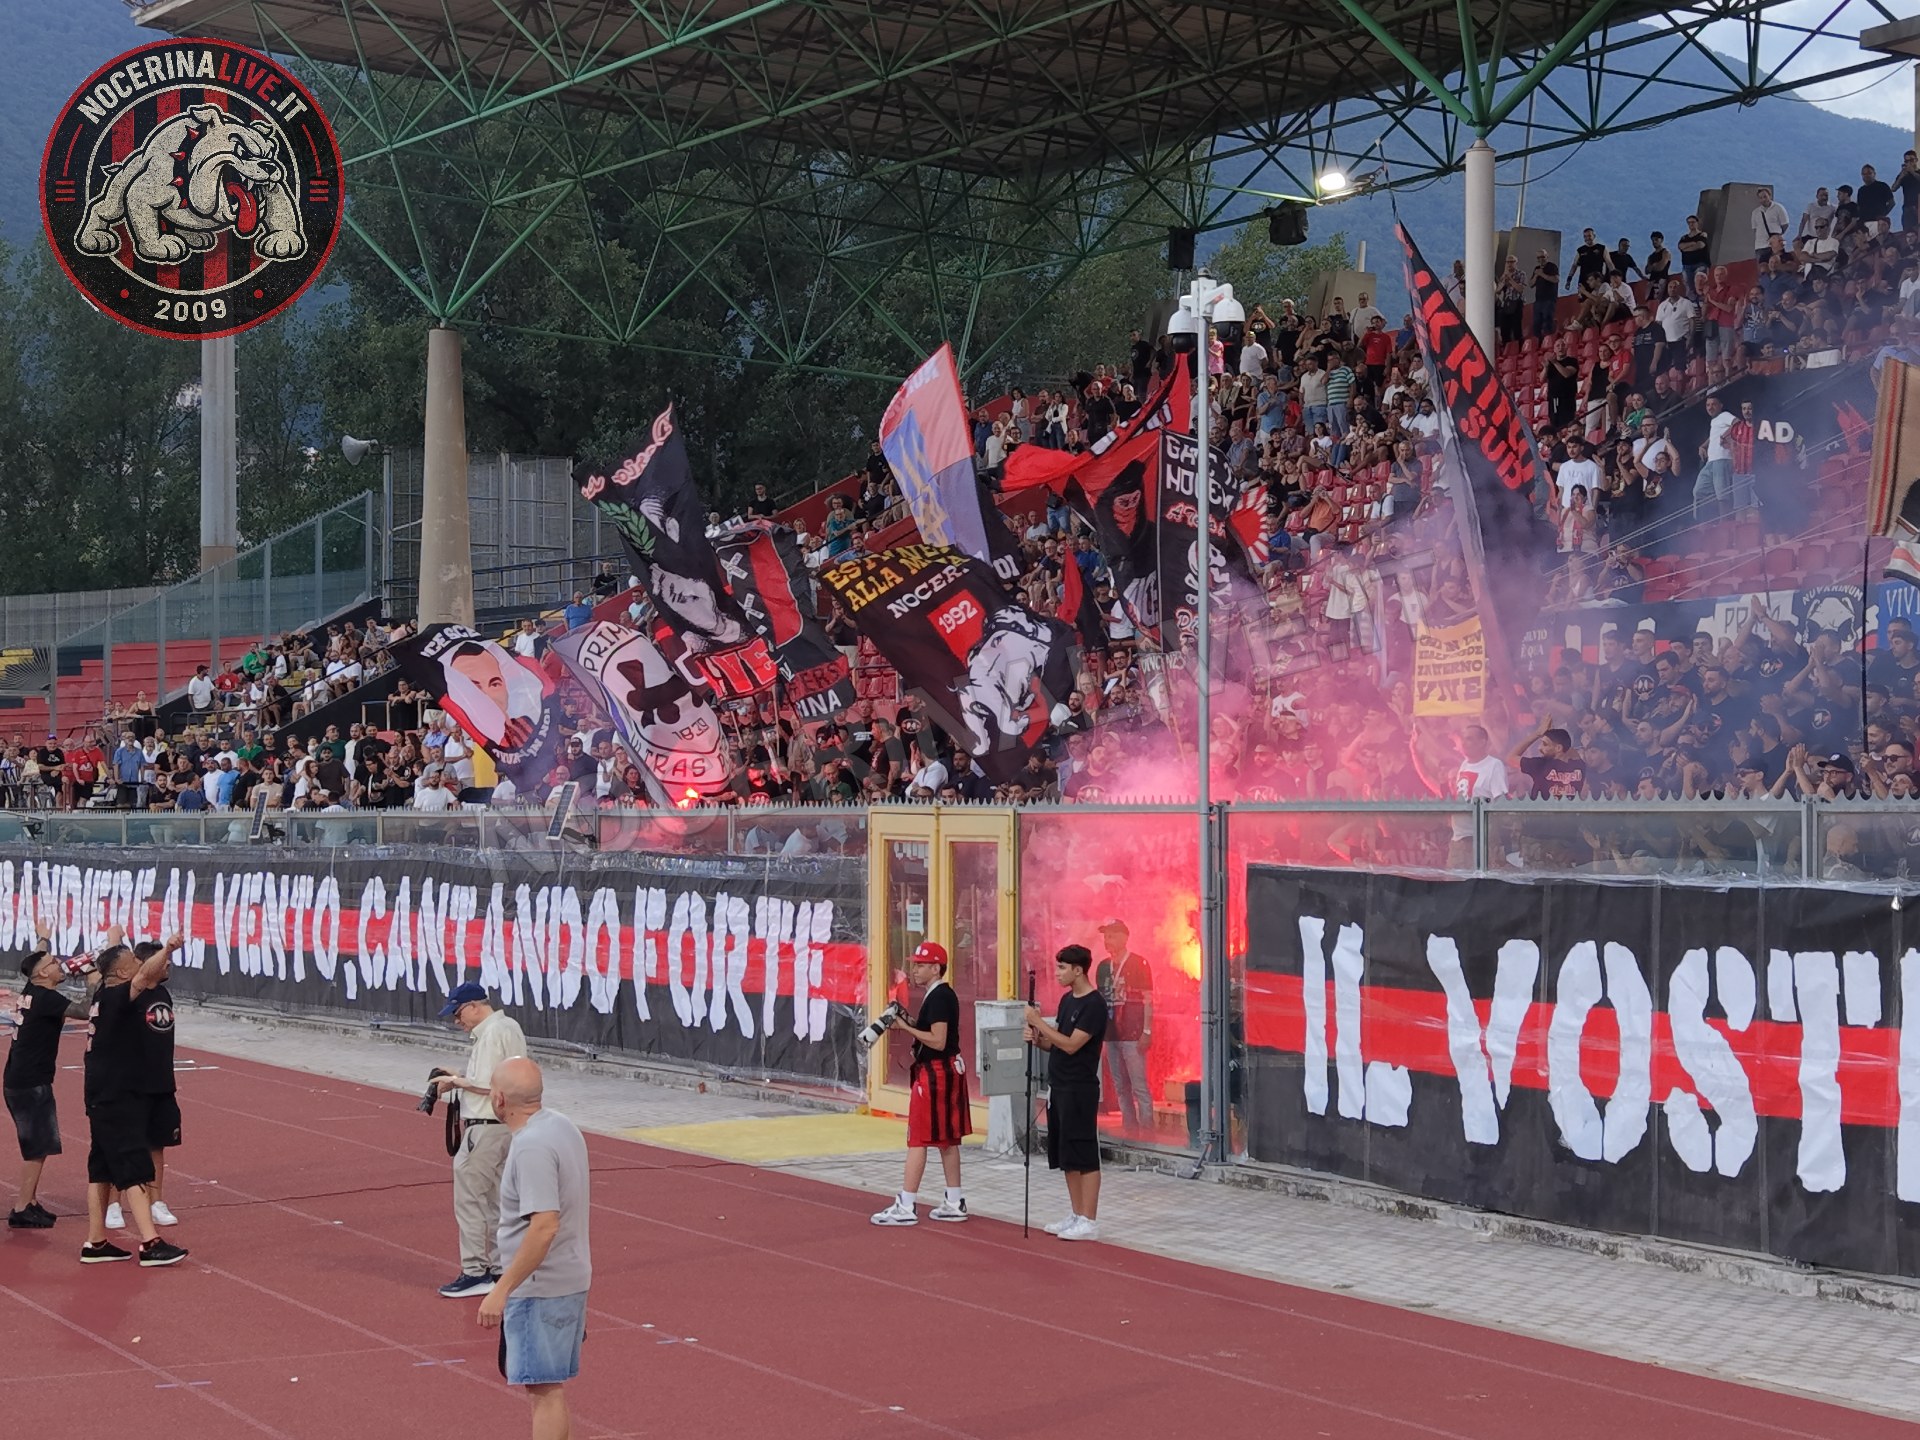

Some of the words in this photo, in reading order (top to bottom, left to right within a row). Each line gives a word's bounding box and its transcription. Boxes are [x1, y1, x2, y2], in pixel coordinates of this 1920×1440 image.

[844, 567, 904, 612] ALLA
[938, 599, 978, 634] 1992
[632, 885, 834, 1044] FORTE
[1298, 915, 1412, 1127] IL
